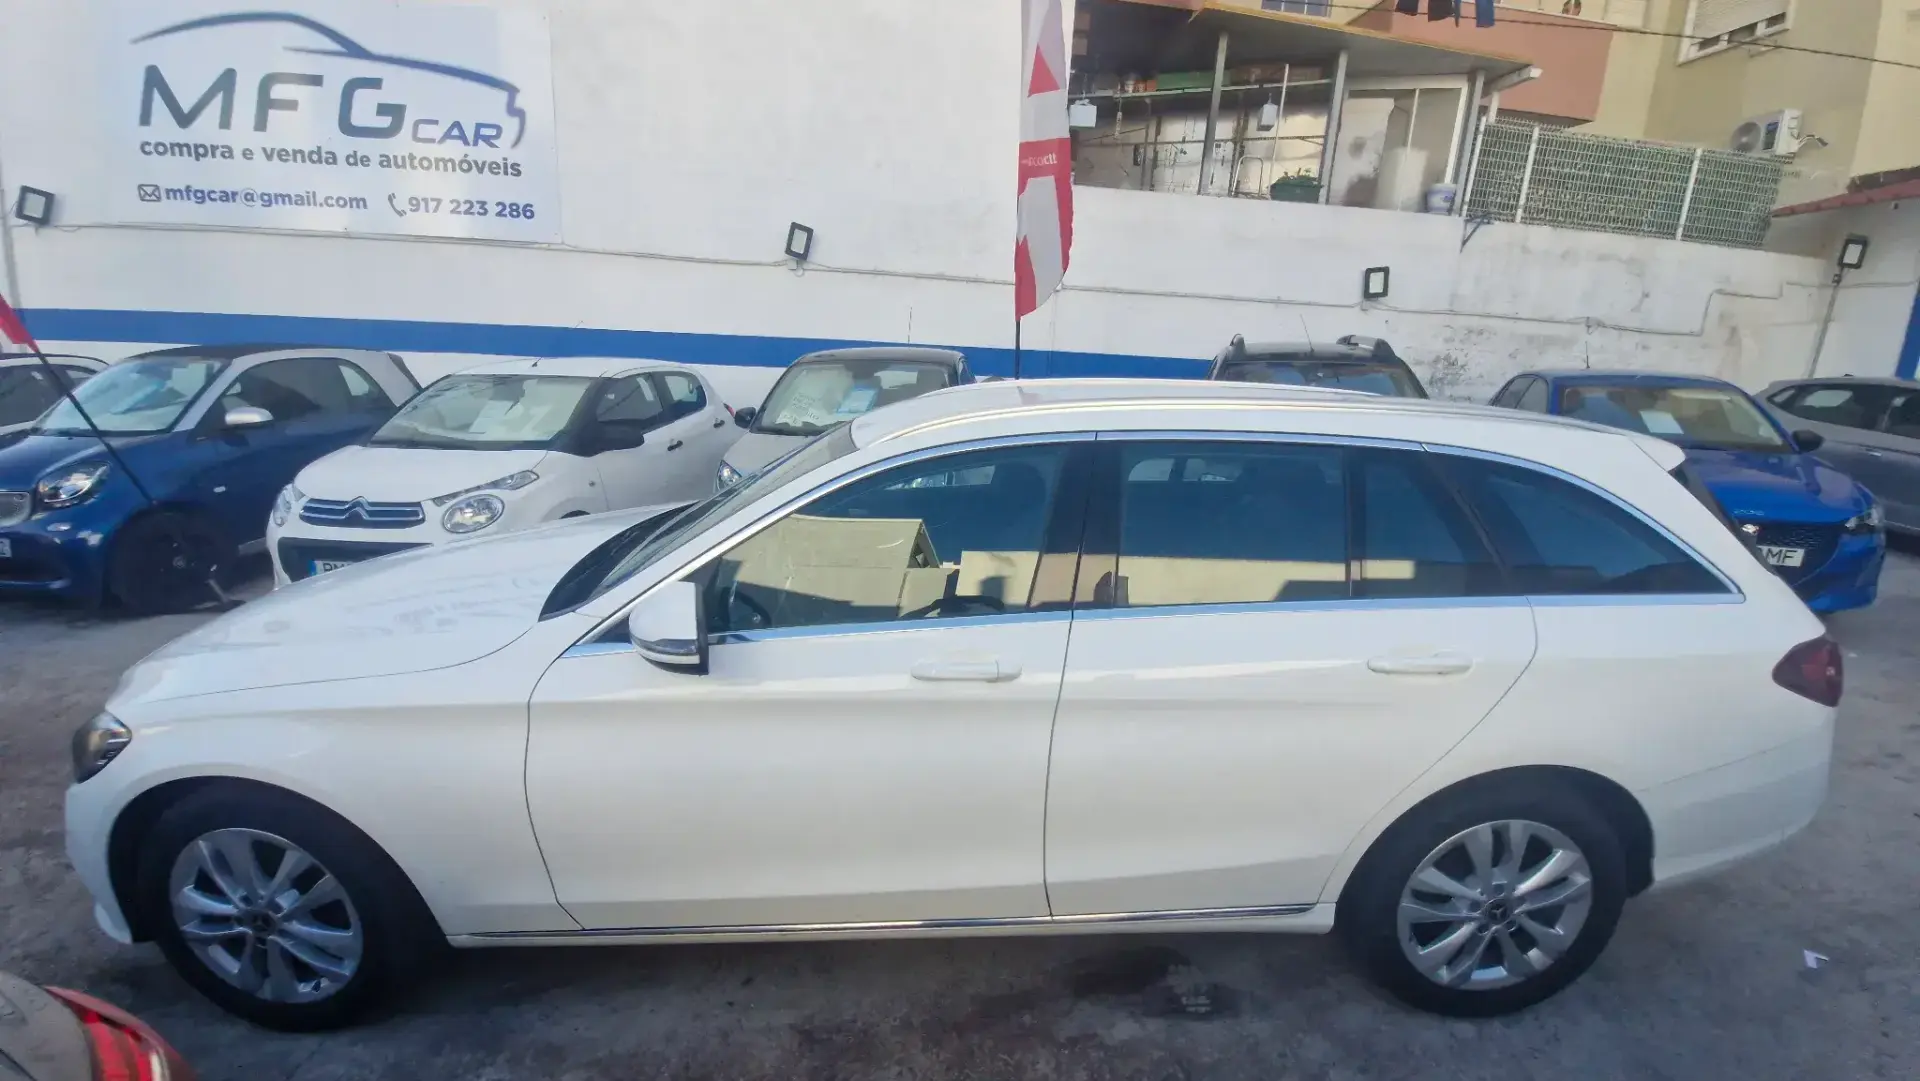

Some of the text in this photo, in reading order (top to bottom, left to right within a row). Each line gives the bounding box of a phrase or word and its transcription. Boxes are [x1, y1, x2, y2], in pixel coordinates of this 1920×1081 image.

[411, 118, 503, 149] CAR
[139, 140, 522, 177] compra e venda de automóveis
[164, 185, 536, 220] mfgcar@gmail.com 917 223 286
